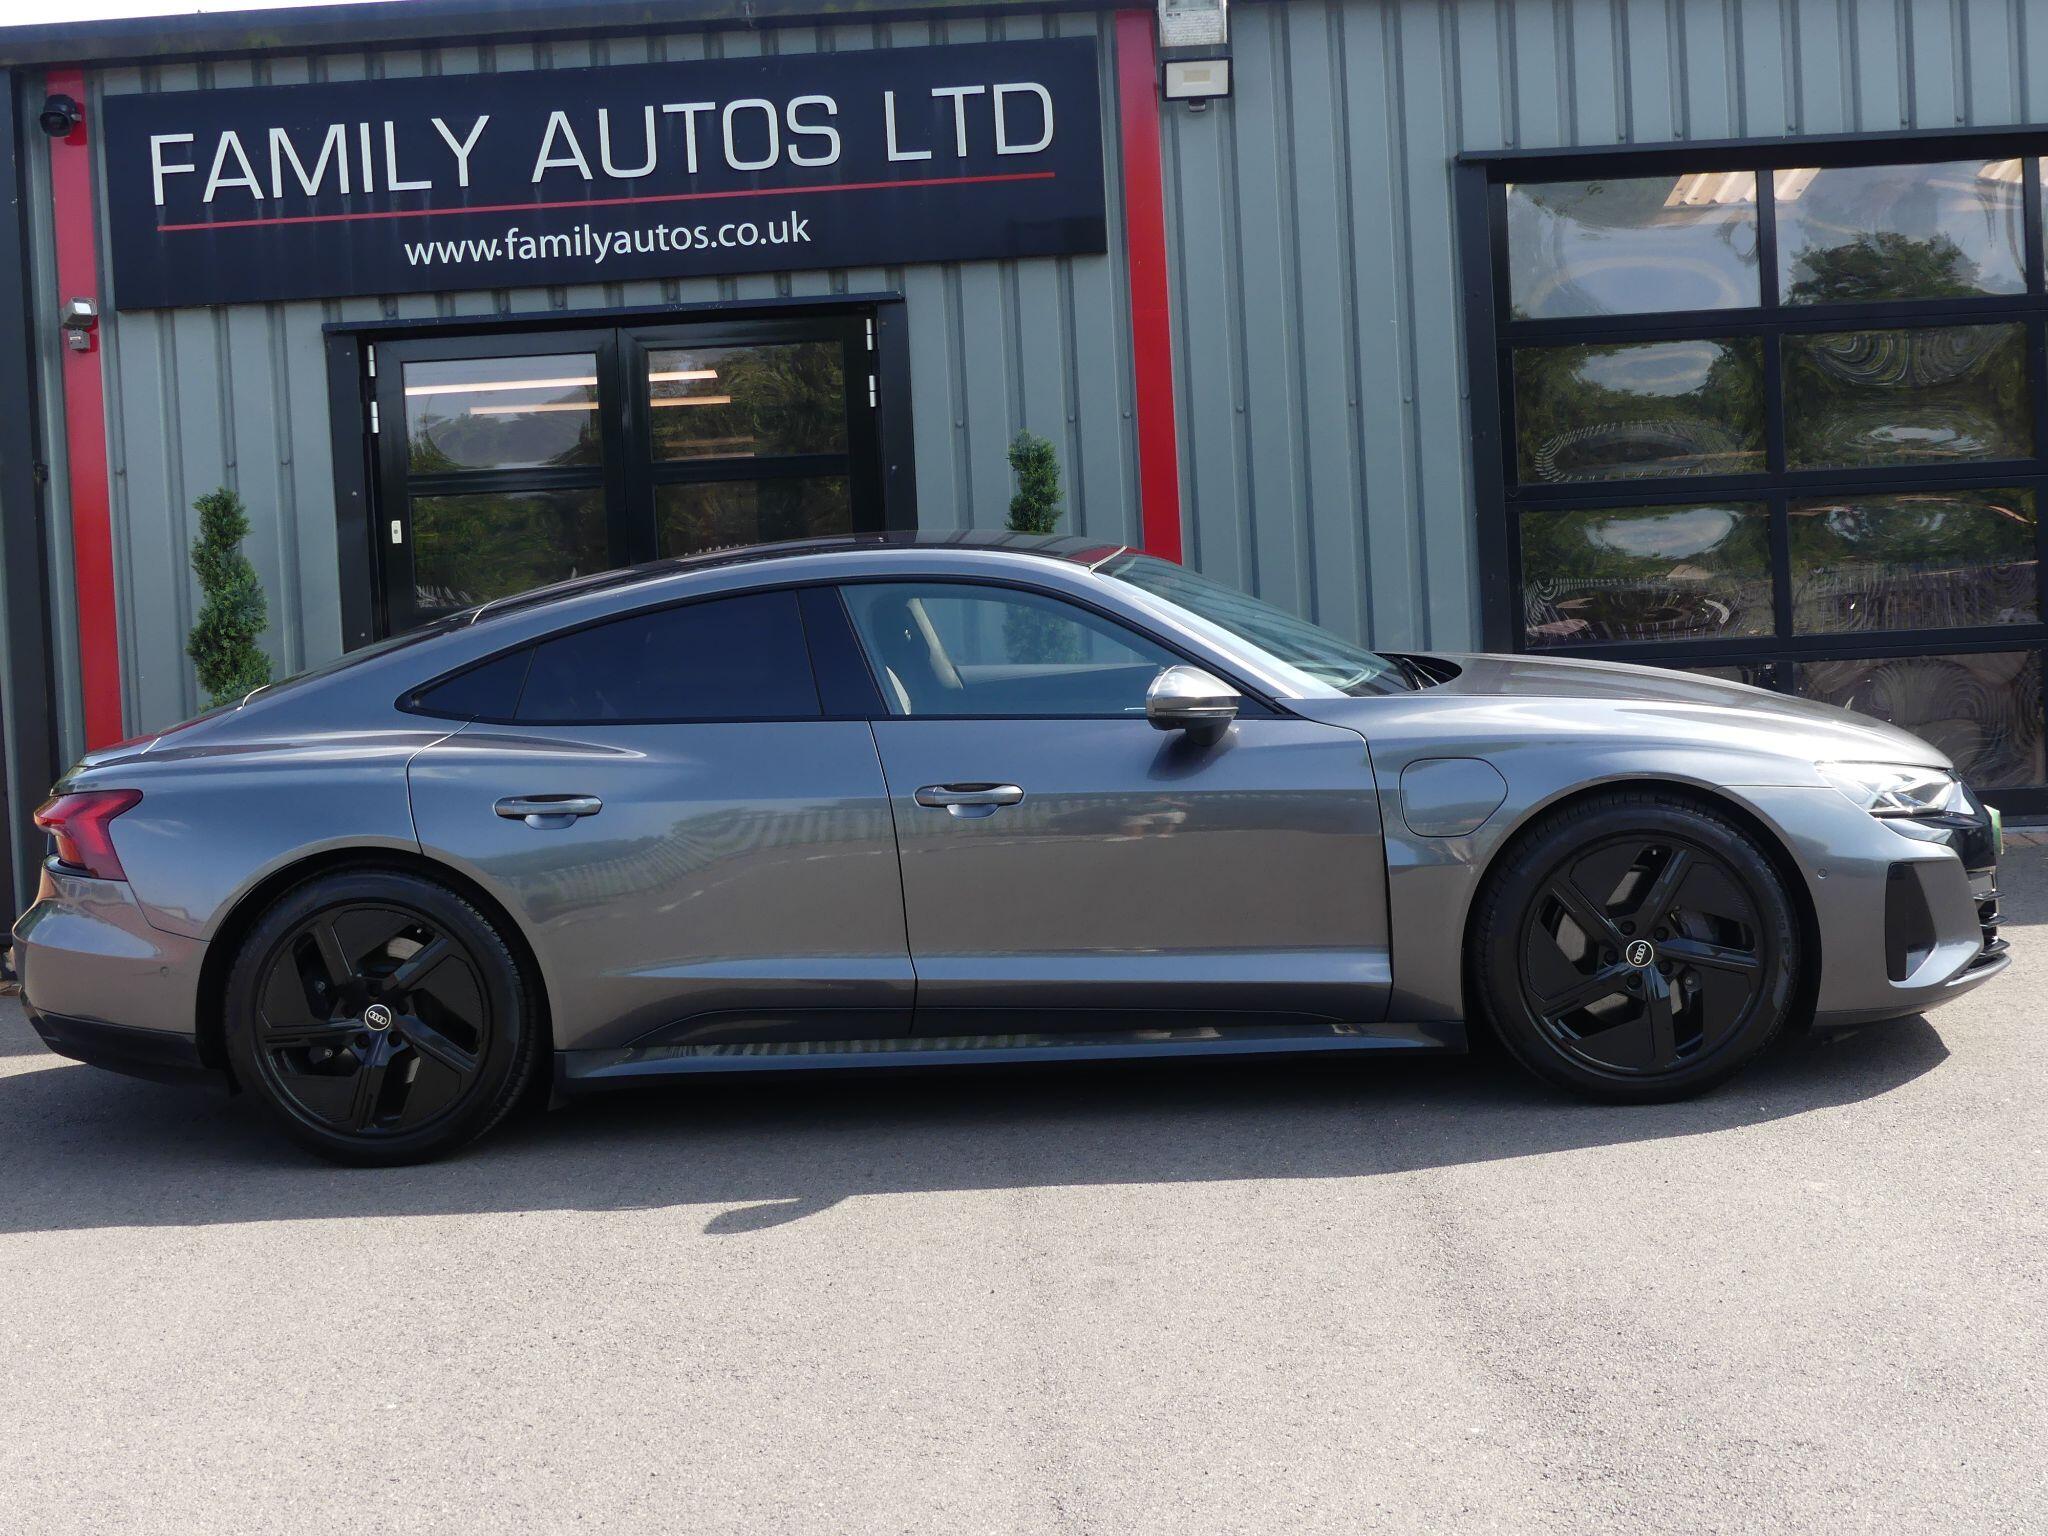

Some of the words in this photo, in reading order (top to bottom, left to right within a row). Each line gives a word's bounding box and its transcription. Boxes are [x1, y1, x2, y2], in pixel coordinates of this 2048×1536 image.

[150, 114, 490, 206] FAMILY
[531, 94, 841, 183] AUTOS
[884, 82, 1054, 162] LTD
[404, 210, 811, 266] www.familyautos.co.uk
